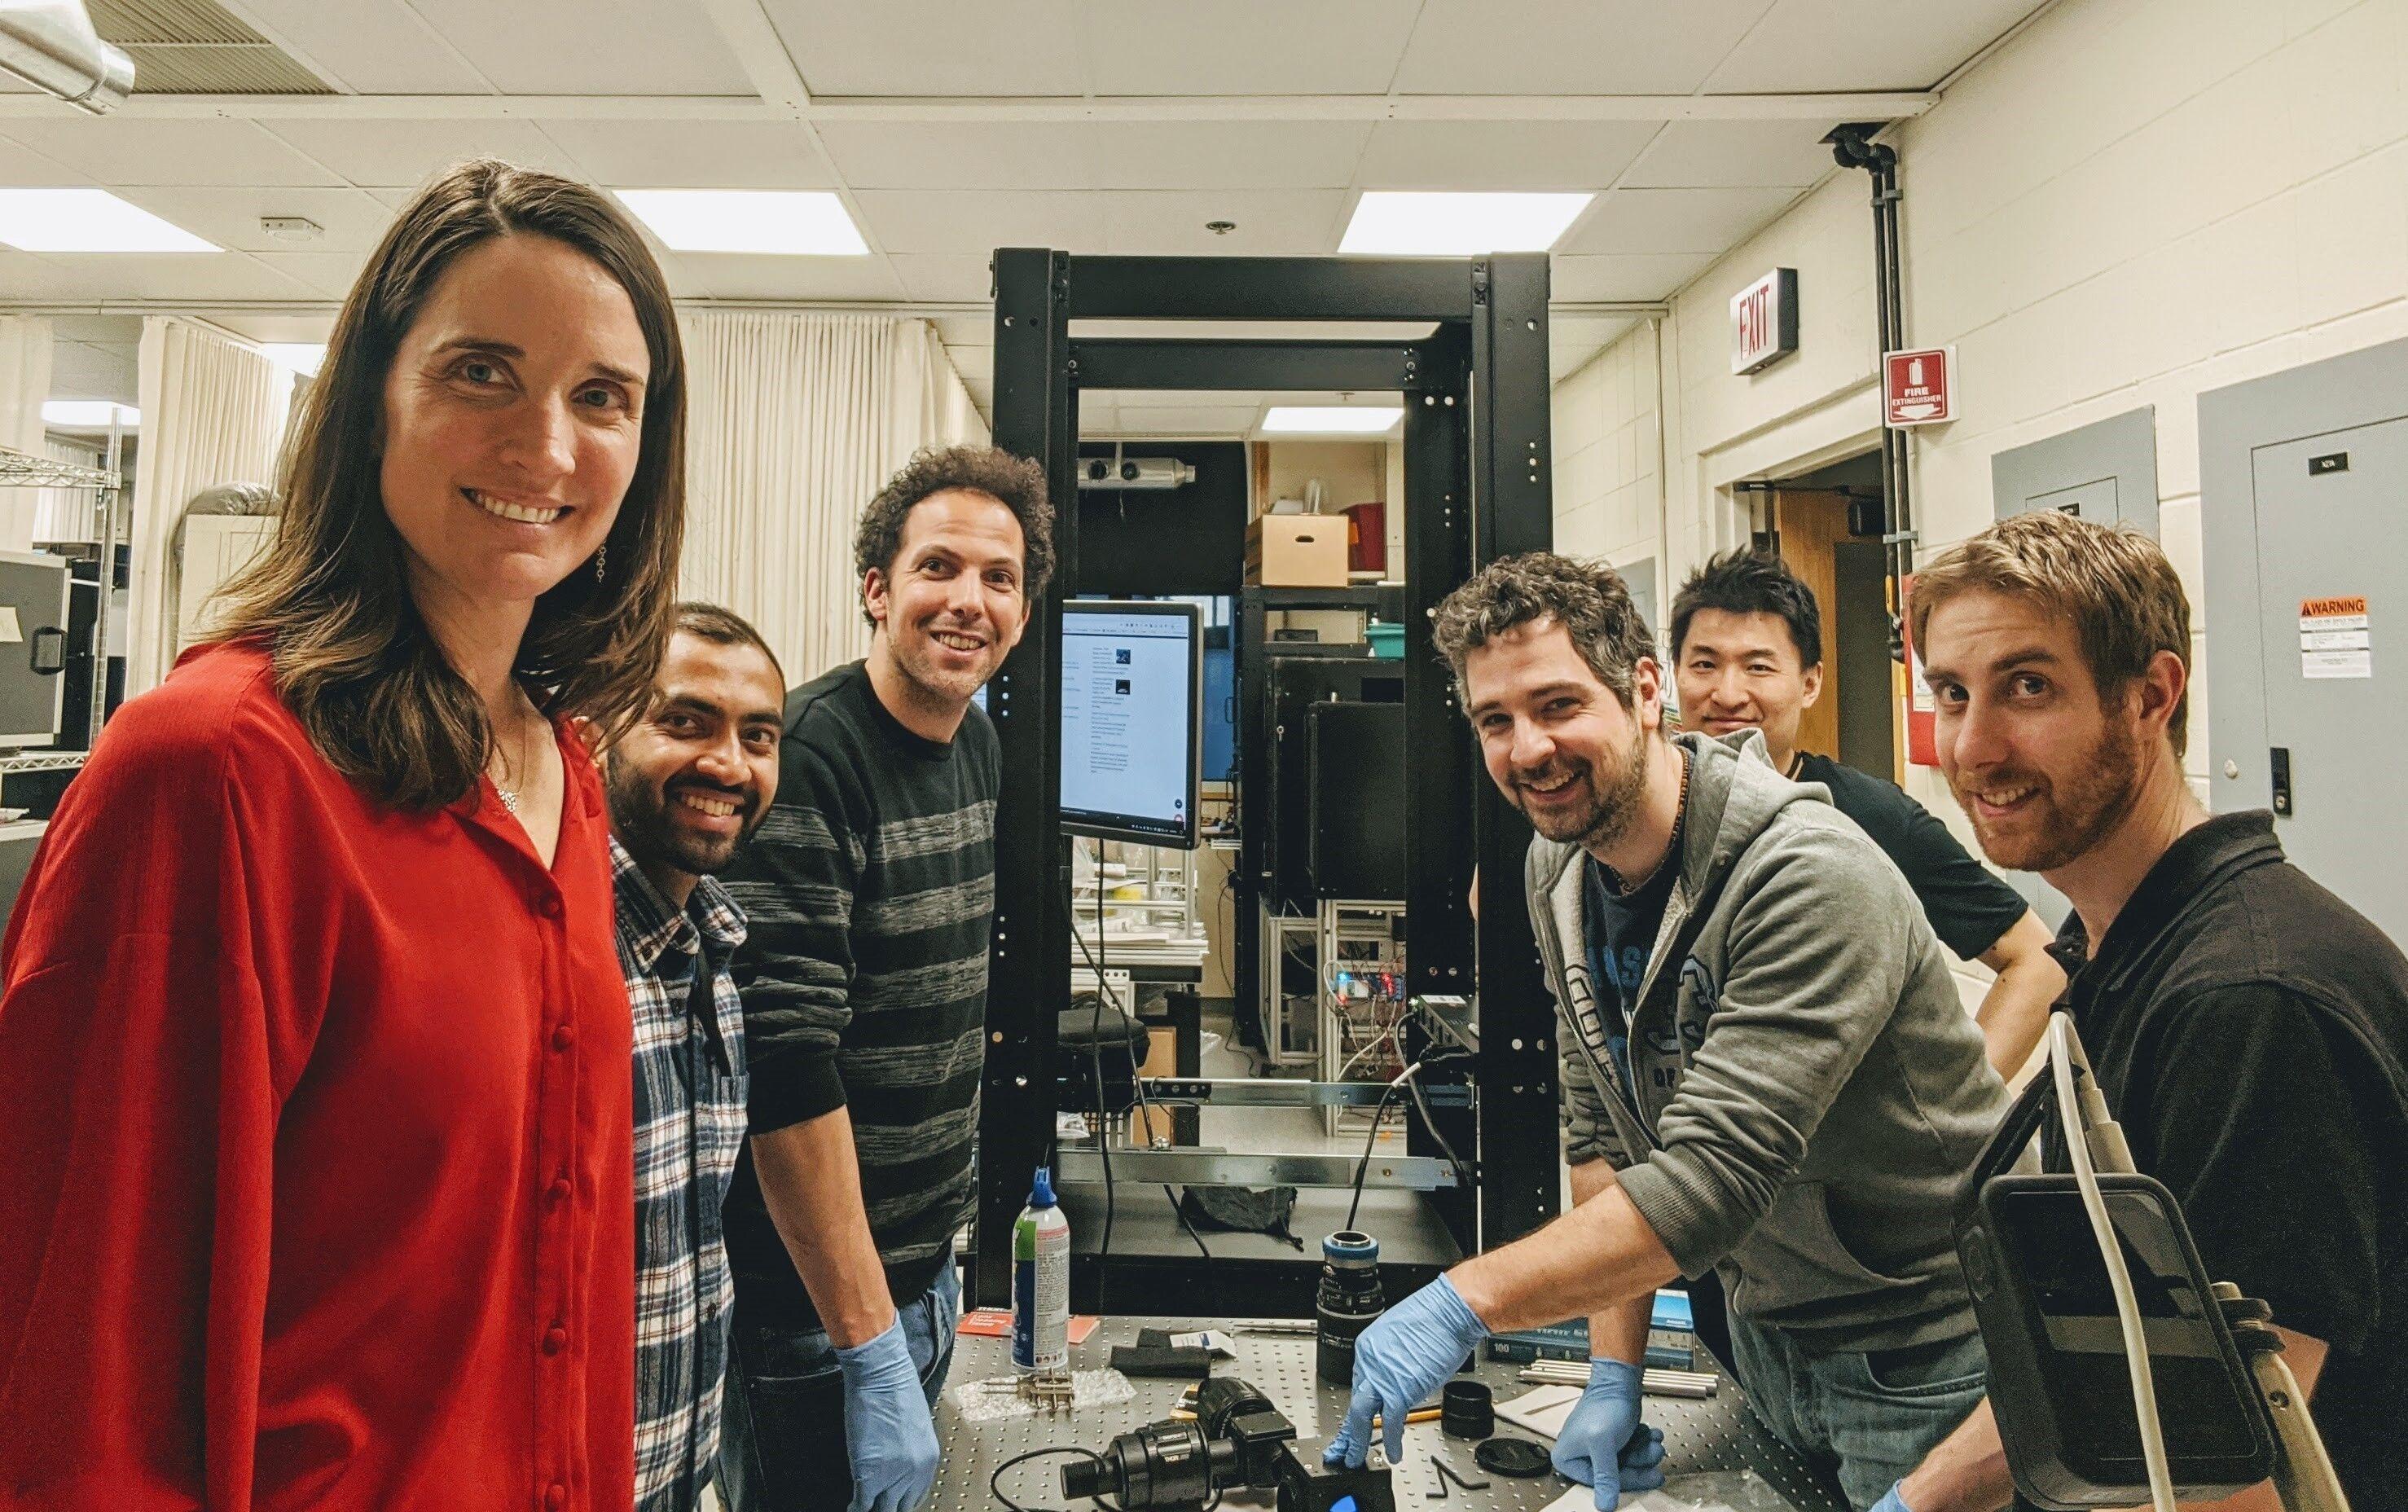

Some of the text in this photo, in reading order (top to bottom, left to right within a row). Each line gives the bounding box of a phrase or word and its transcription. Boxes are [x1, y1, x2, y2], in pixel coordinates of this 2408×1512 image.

[1739, 284, 1769, 360] EXIT
[1904, 386, 1929, 398] FIRE
[1892, 394, 1942, 407] EXTINGUISHER
[2311, 599, 2365, 615] WARNING
